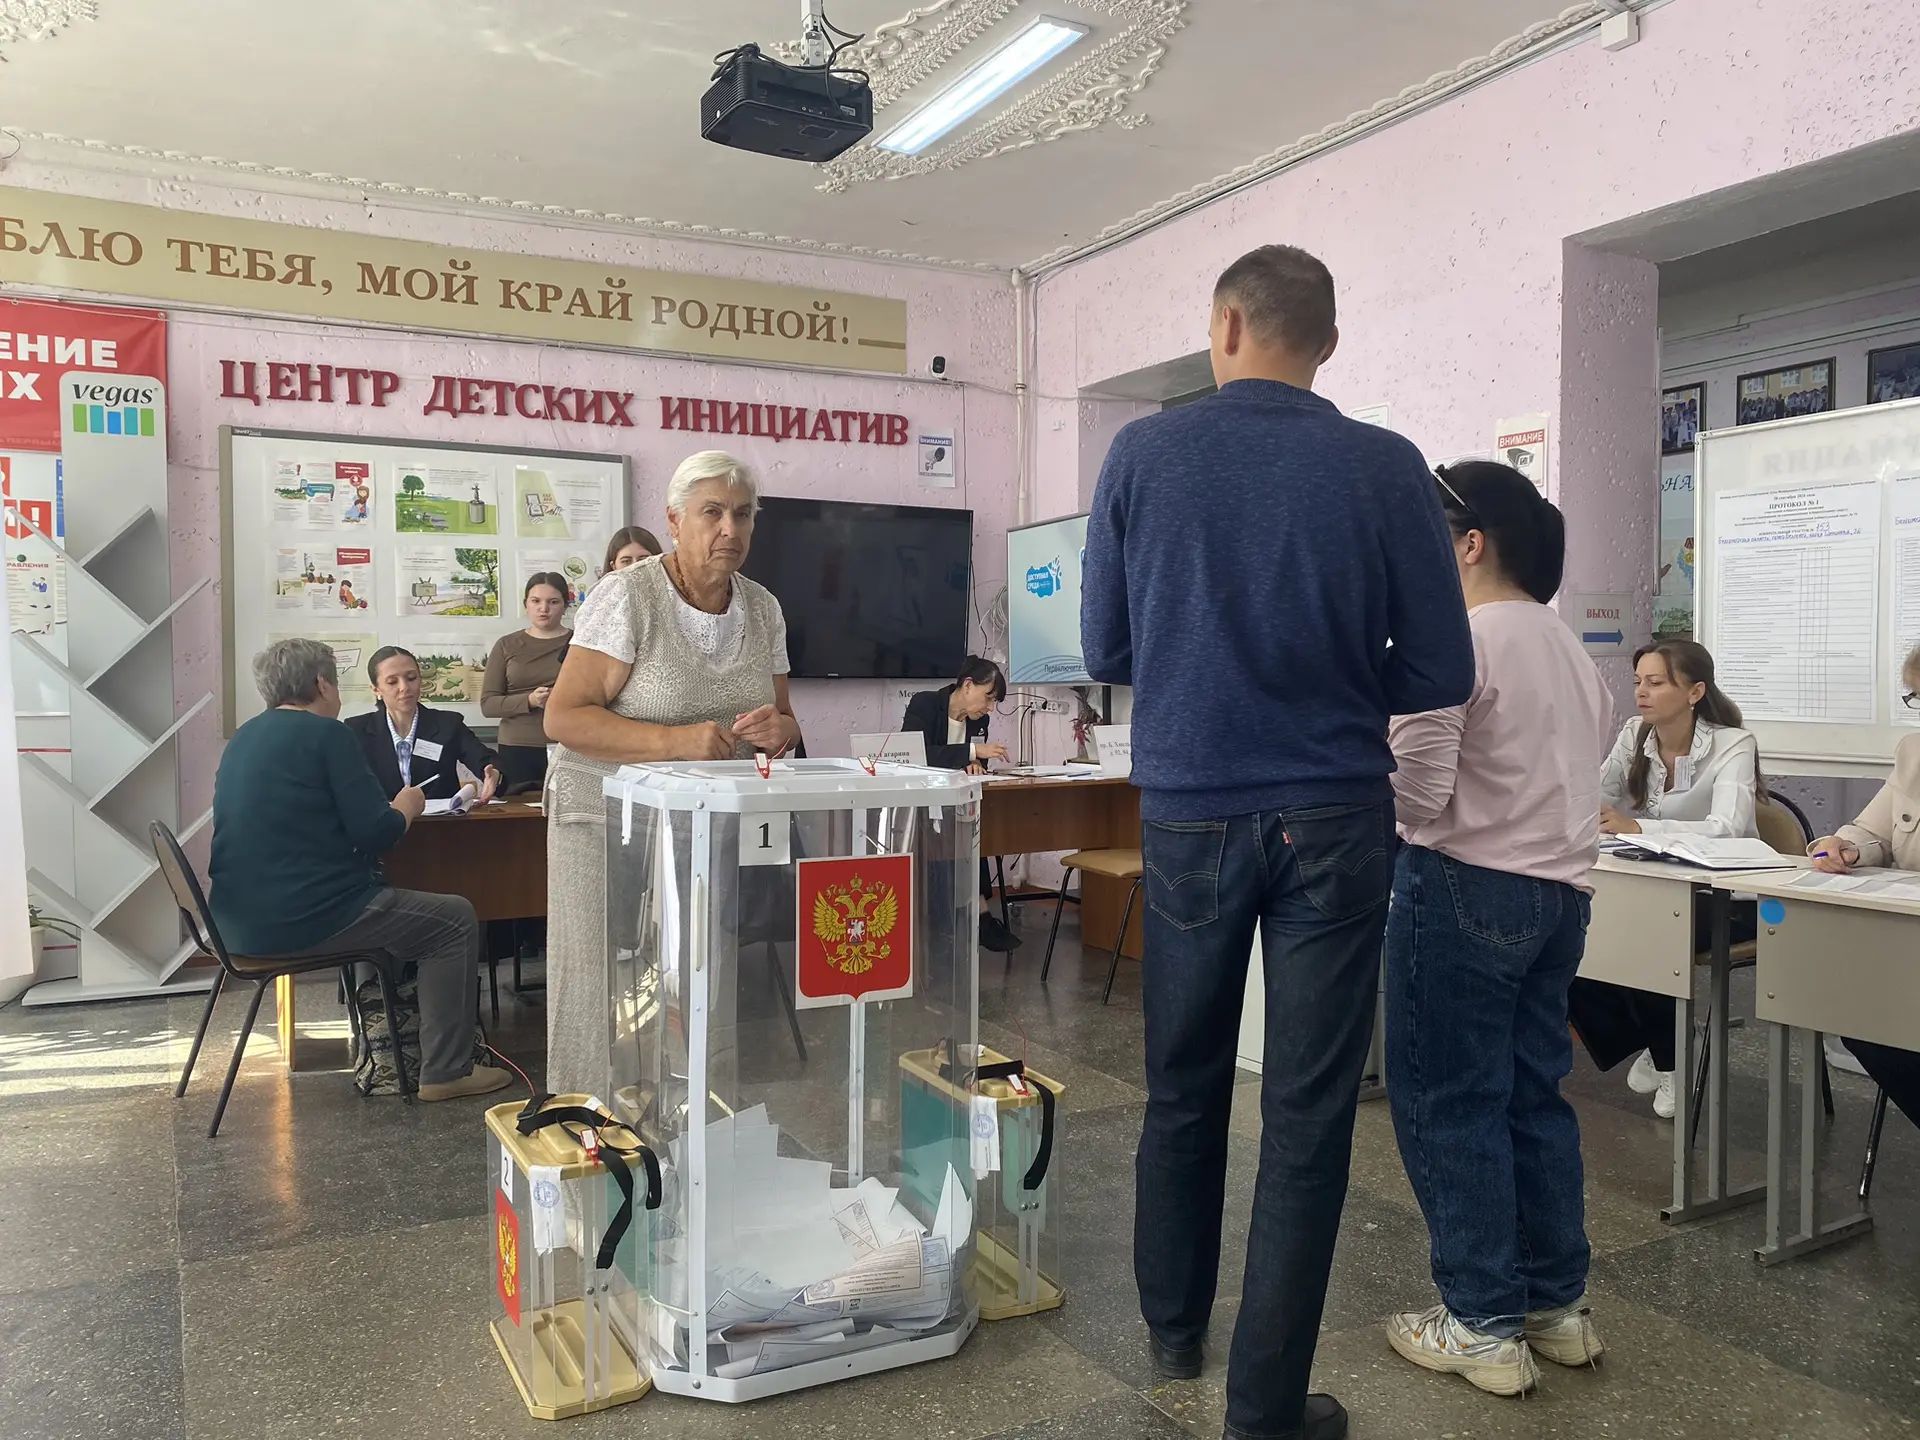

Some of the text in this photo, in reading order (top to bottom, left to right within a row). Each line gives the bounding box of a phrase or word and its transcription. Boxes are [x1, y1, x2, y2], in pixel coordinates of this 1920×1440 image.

[167, 238, 333, 295] ТЕБЯ,
[356, 258, 479, 305] МОЙ
[499, 277, 633, 322] КРАЙ
[650, 295, 849, 345] РОДНОЙ!
[73, 384, 153, 407] vegas
[219, 359, 910, 446] ЦЕНТР ДЕТСКИХ ИНИЦИАТИВ
[1499, 430, 1544, 448] ВНИМАНИЕ
[1586, 608, 1620, 620] ВЫХОД
[758, 822, 773, 849] 1
